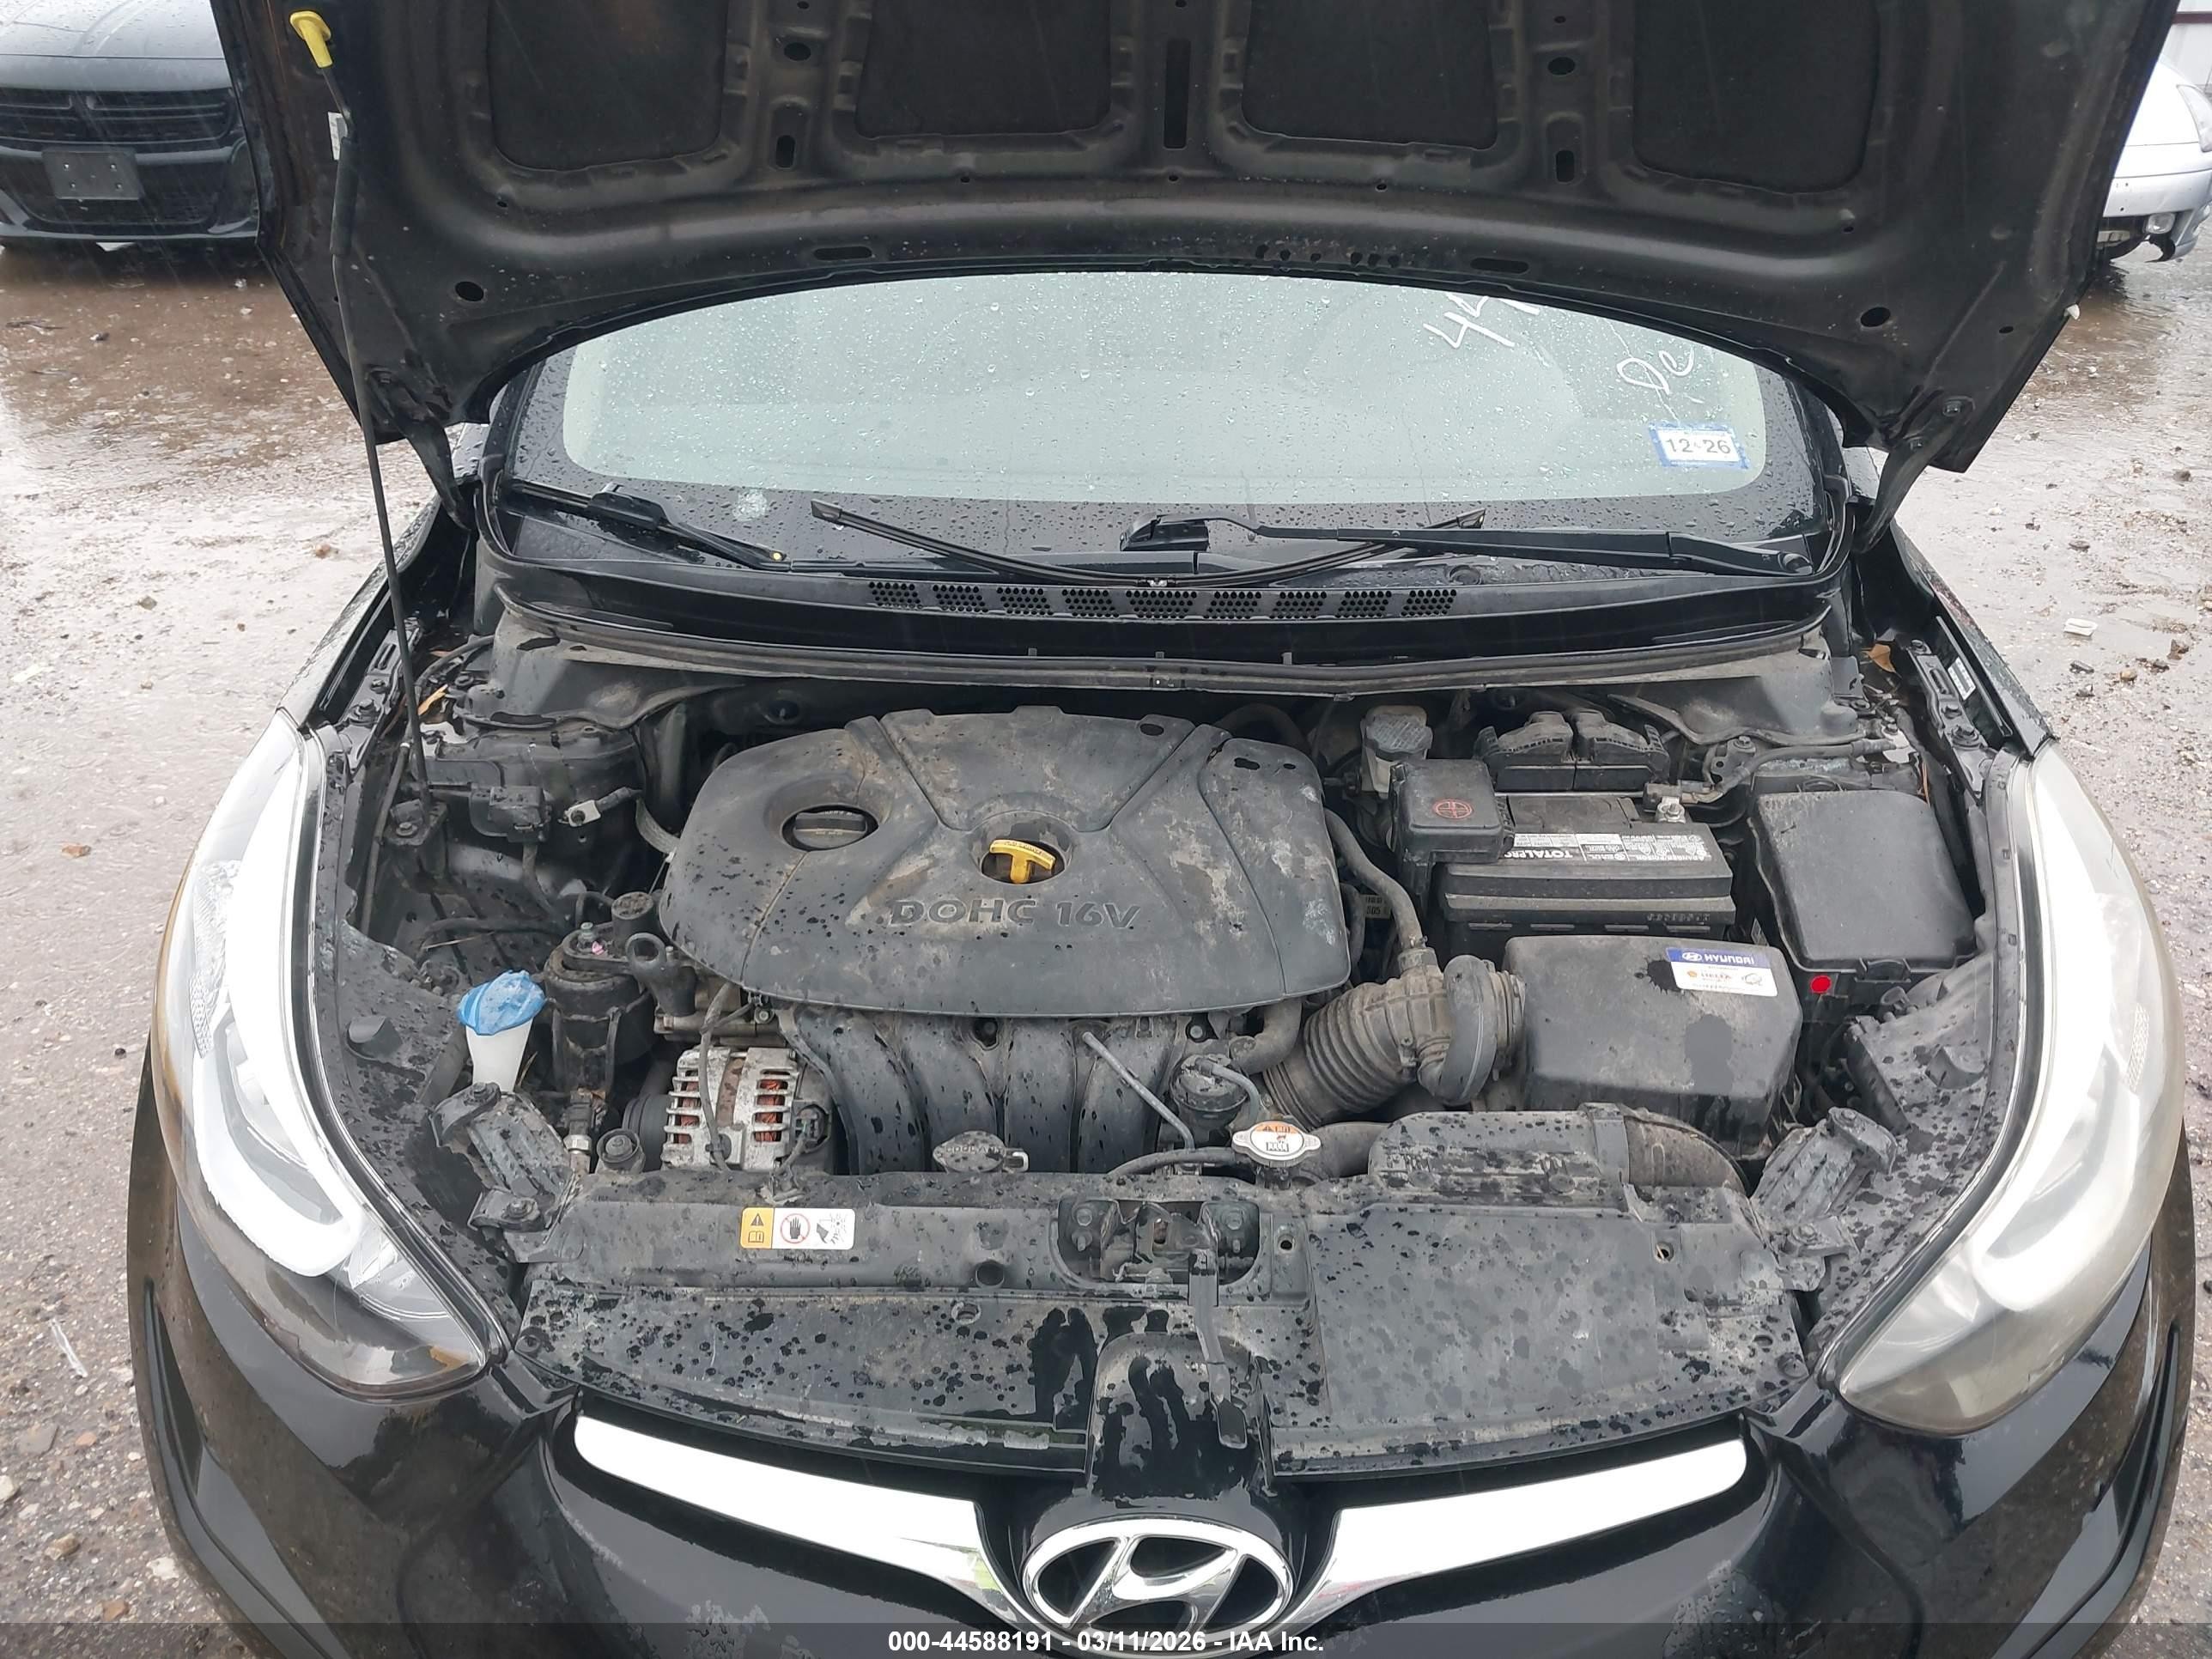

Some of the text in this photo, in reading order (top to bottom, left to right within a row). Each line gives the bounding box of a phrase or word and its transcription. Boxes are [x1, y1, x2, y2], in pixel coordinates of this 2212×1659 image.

[889, 898, 1142, 928] DOHC 16V
[1705, 953, 1755, 965] HYUNDAI
